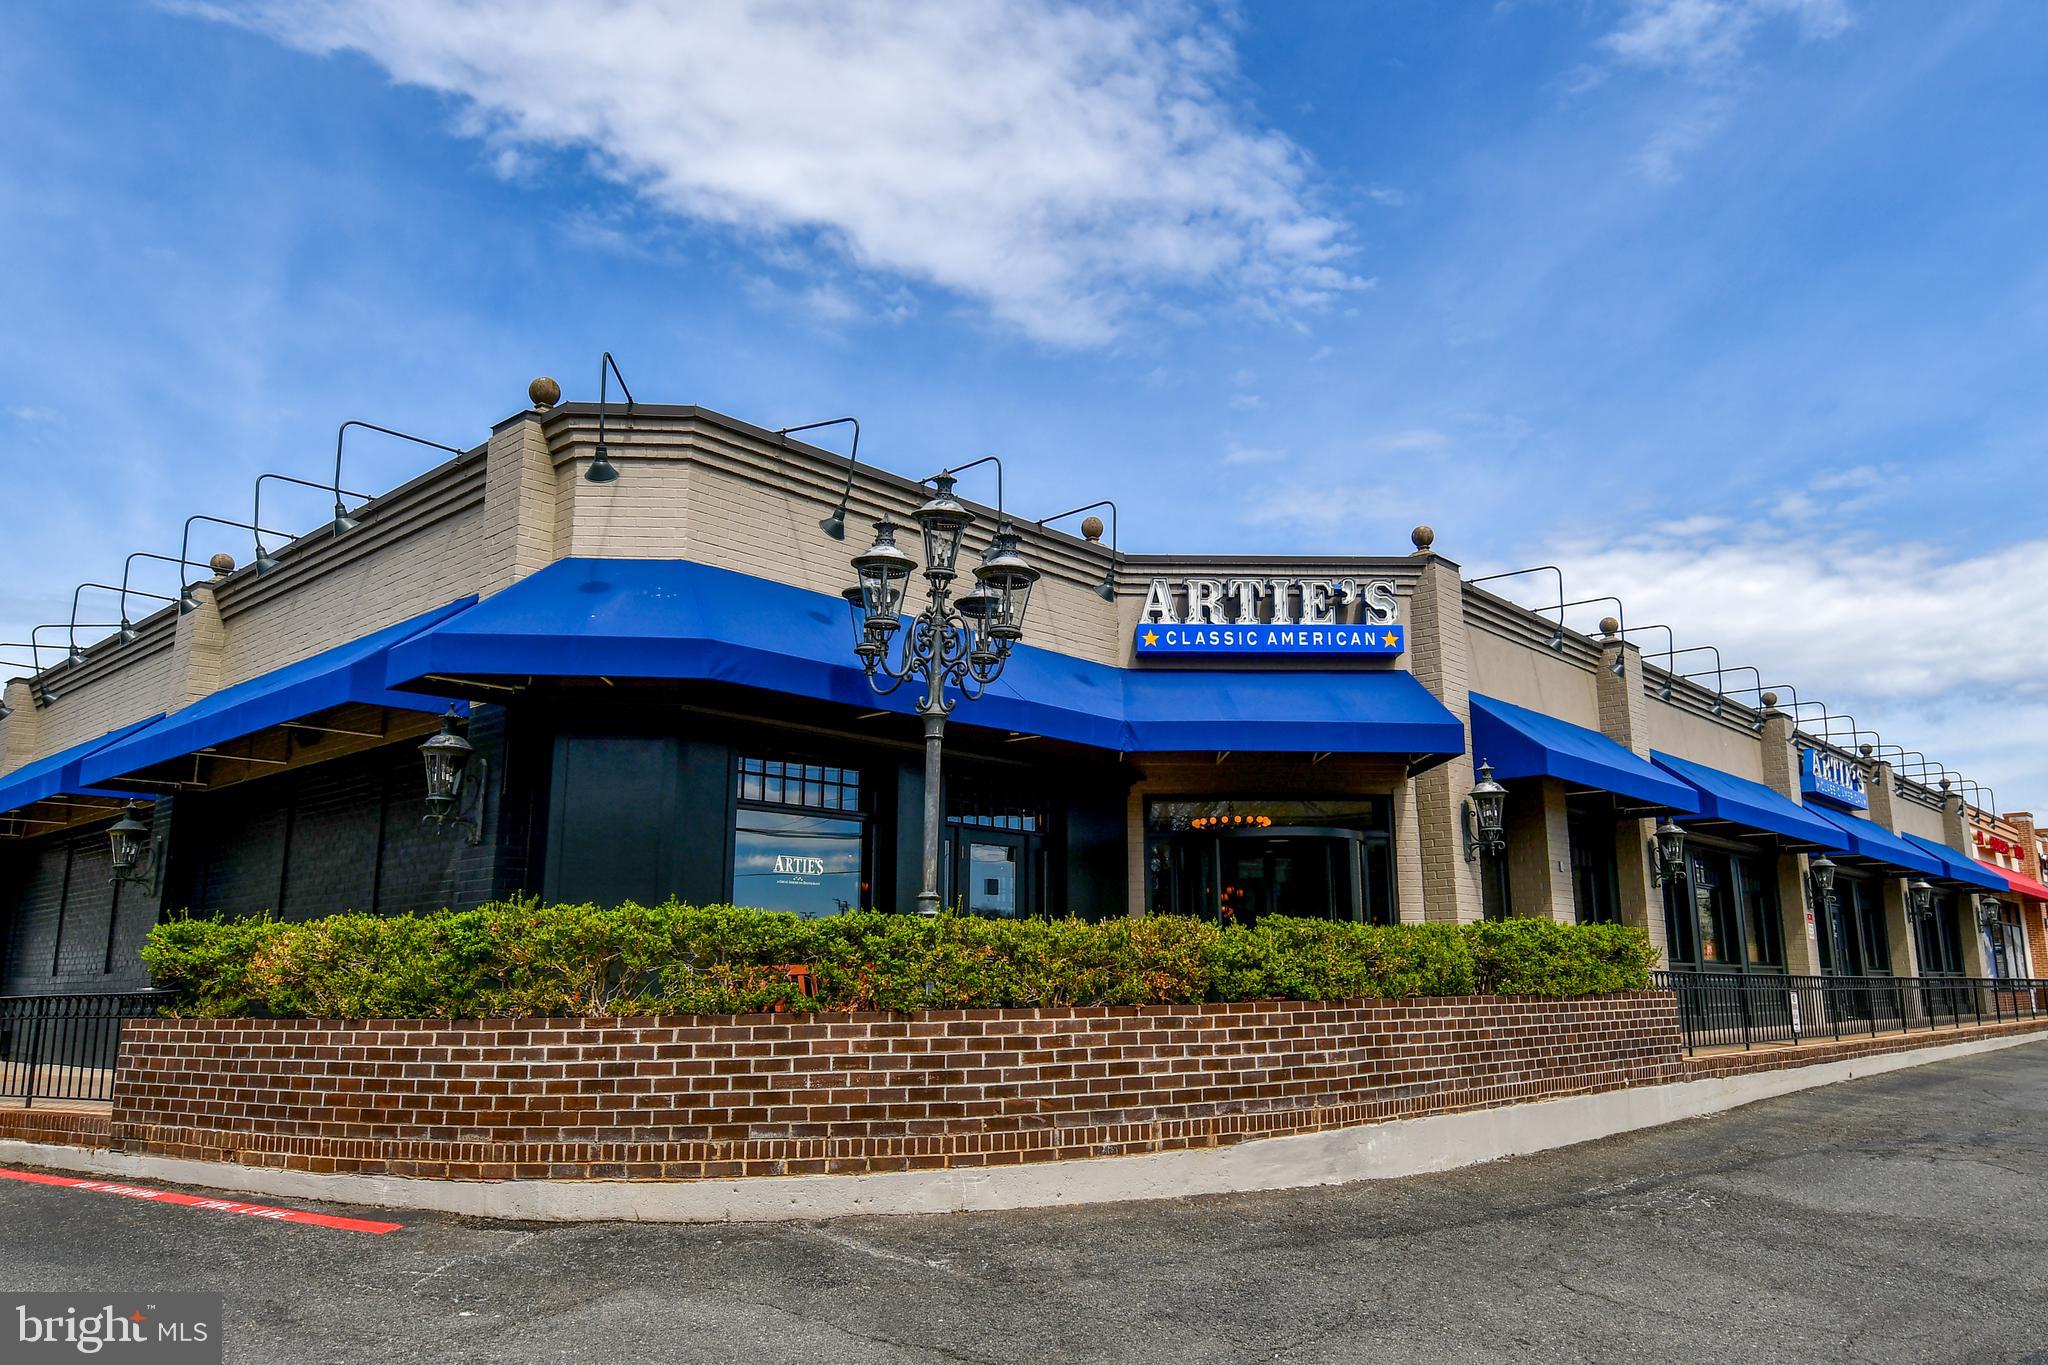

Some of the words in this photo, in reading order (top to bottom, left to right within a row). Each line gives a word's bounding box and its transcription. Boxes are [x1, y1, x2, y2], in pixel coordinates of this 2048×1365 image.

[1139, 577, 1398, 626] ARTIE'S
[1166, 630, 1258, 645] CLASSIC
[1267, 631, 1377, 646] AMERICAN
[773, 855, 824, 875] ARTIE'S
